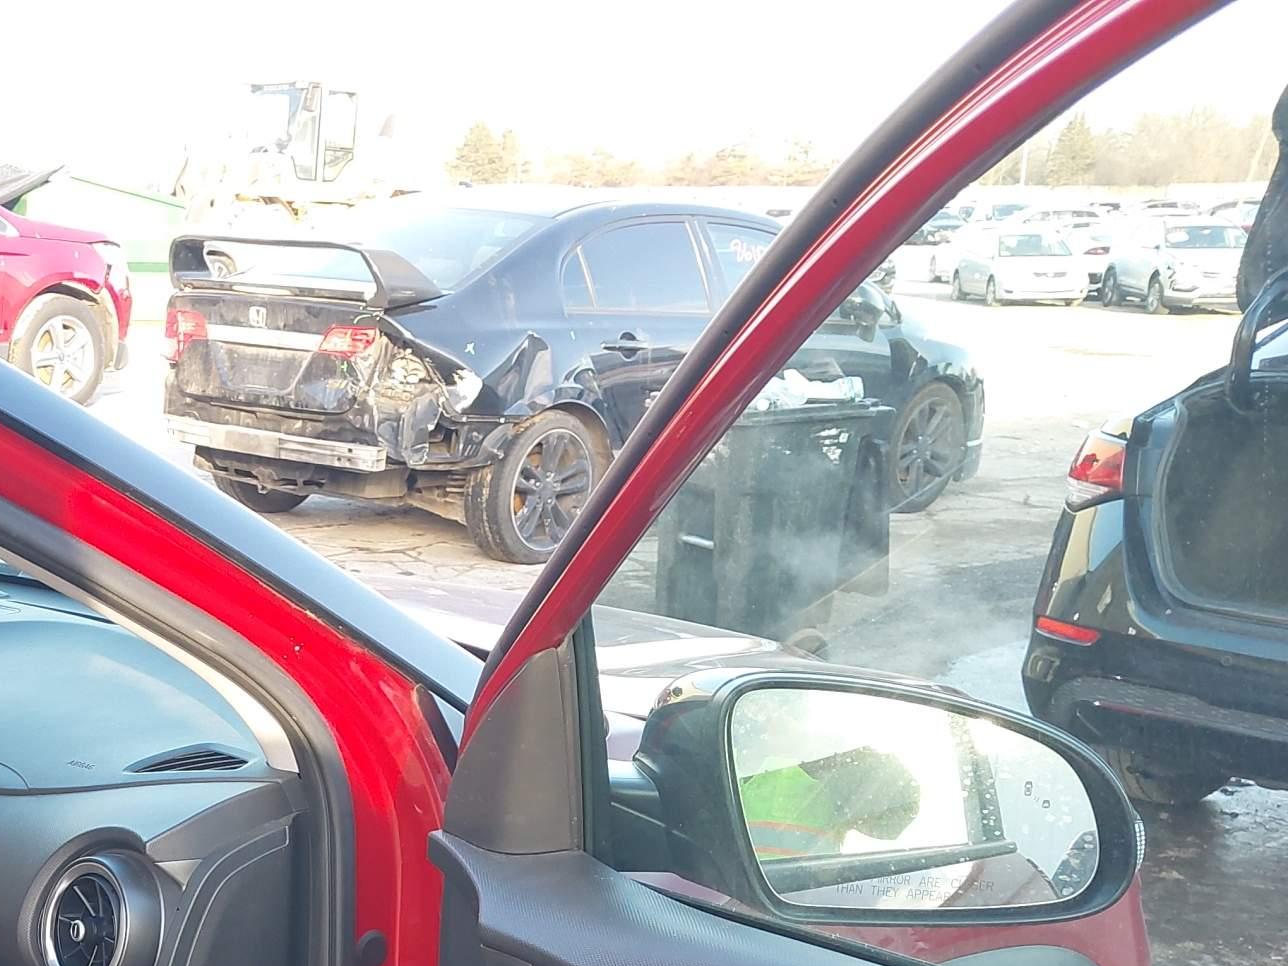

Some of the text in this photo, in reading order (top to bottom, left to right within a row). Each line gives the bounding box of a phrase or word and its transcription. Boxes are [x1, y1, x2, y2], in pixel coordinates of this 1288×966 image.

[919, 876, 941, 888] ARE
[837, 884, 864, 895] THAN
[872, 885, 899, 897] THEY
